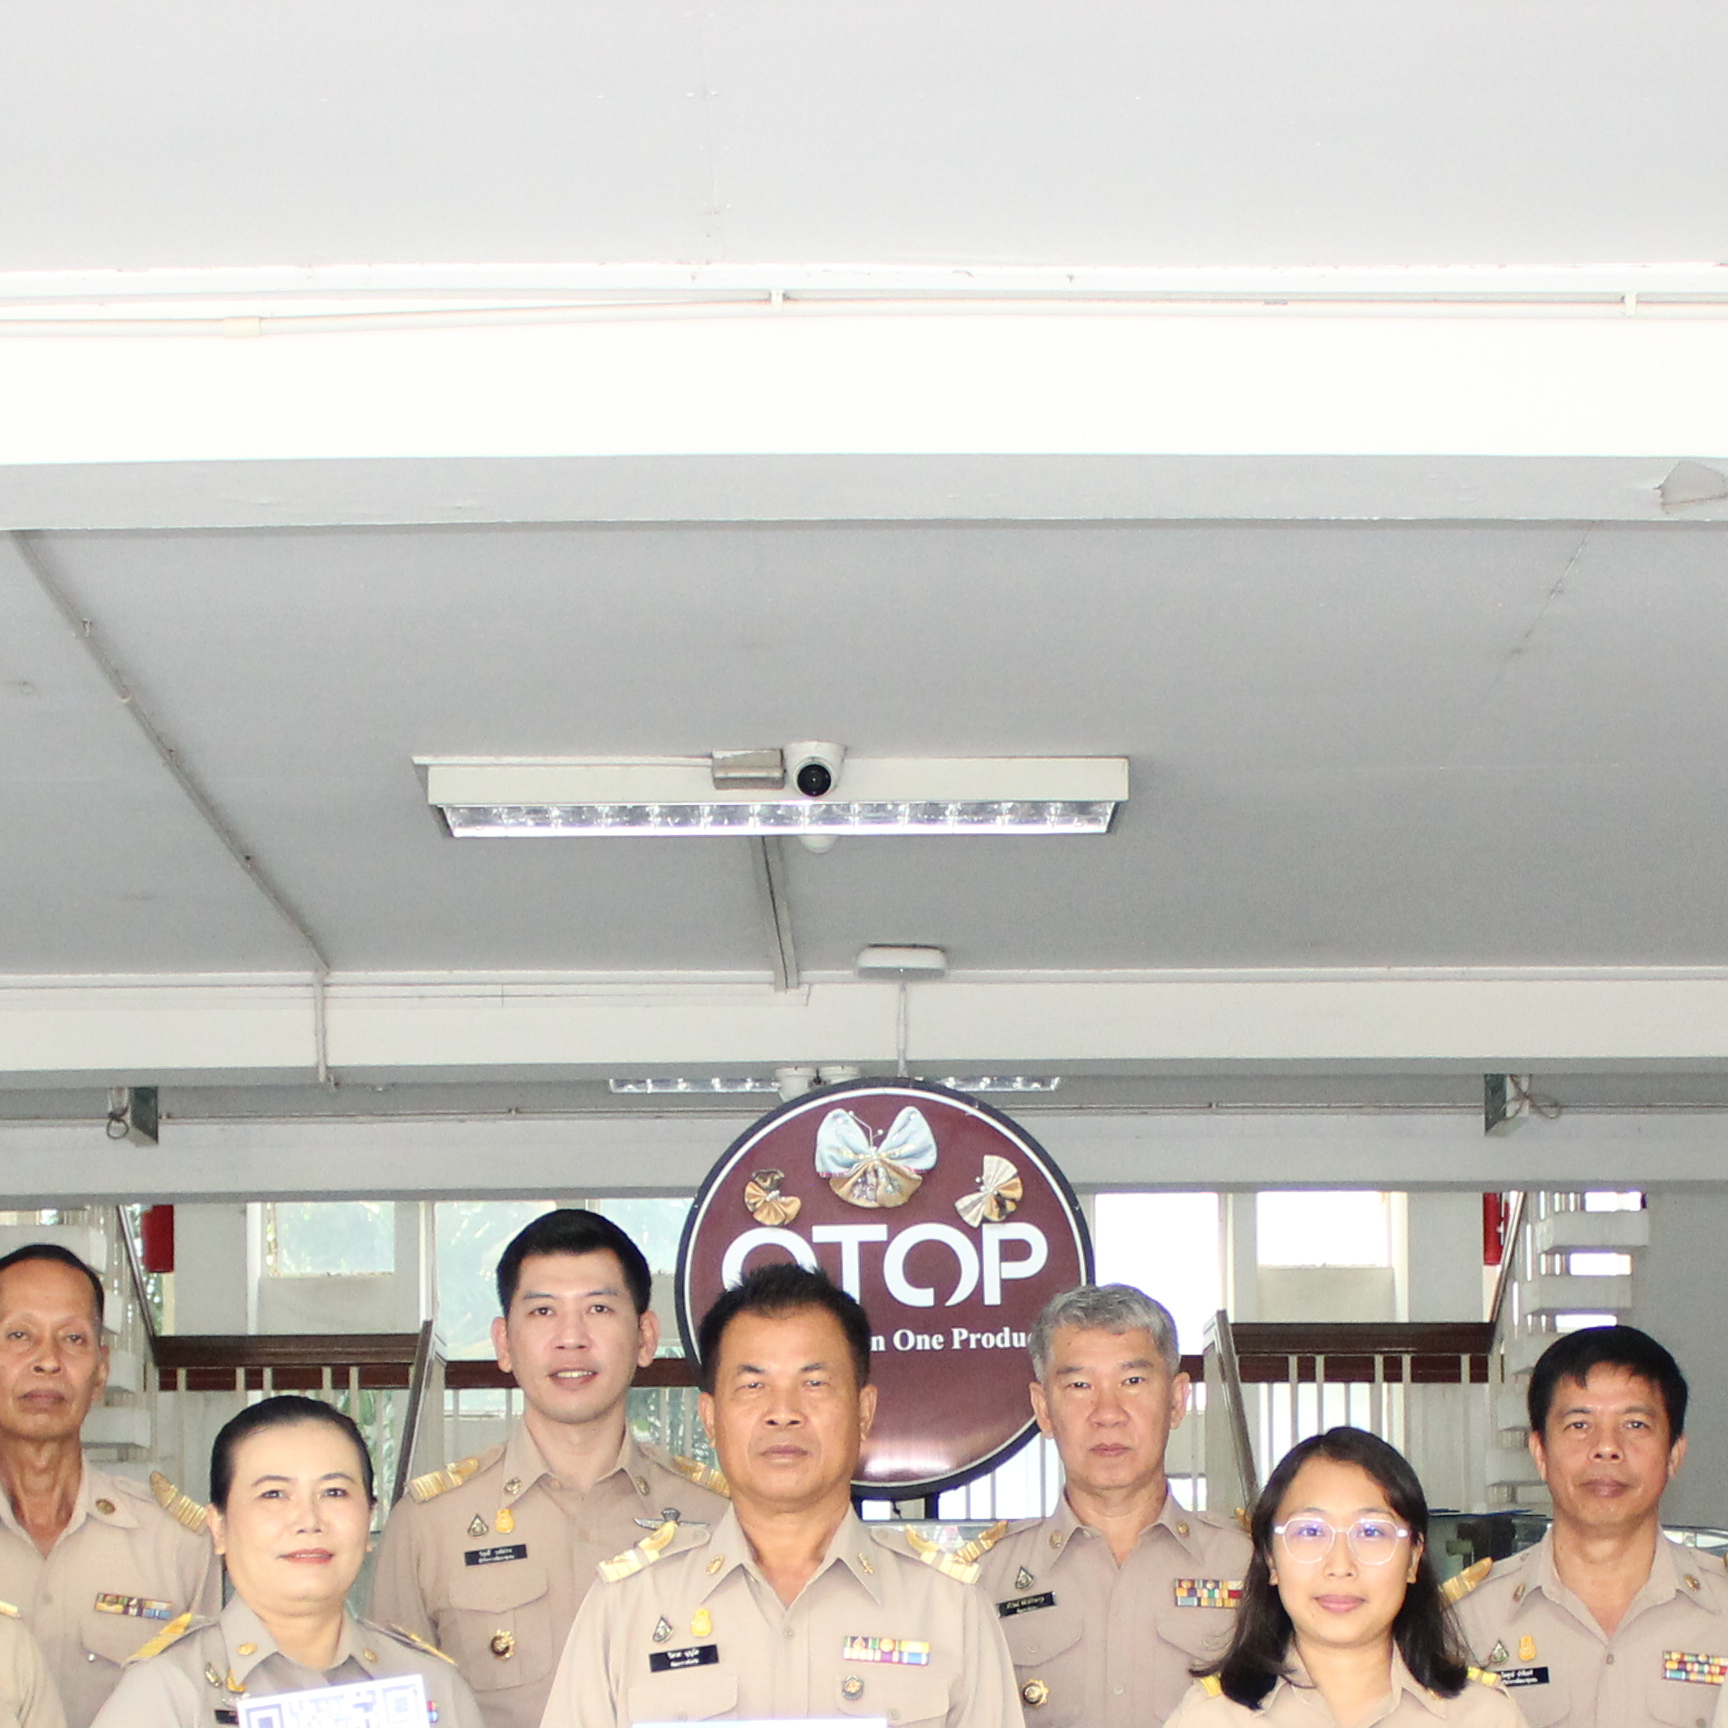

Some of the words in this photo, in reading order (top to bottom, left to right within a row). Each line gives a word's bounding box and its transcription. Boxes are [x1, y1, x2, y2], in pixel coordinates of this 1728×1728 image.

[721, 1222, 1049, 1309] OTOP
[892, 1328, 945, 1352] One
[951, 1326, 1033, 1350] Produ
